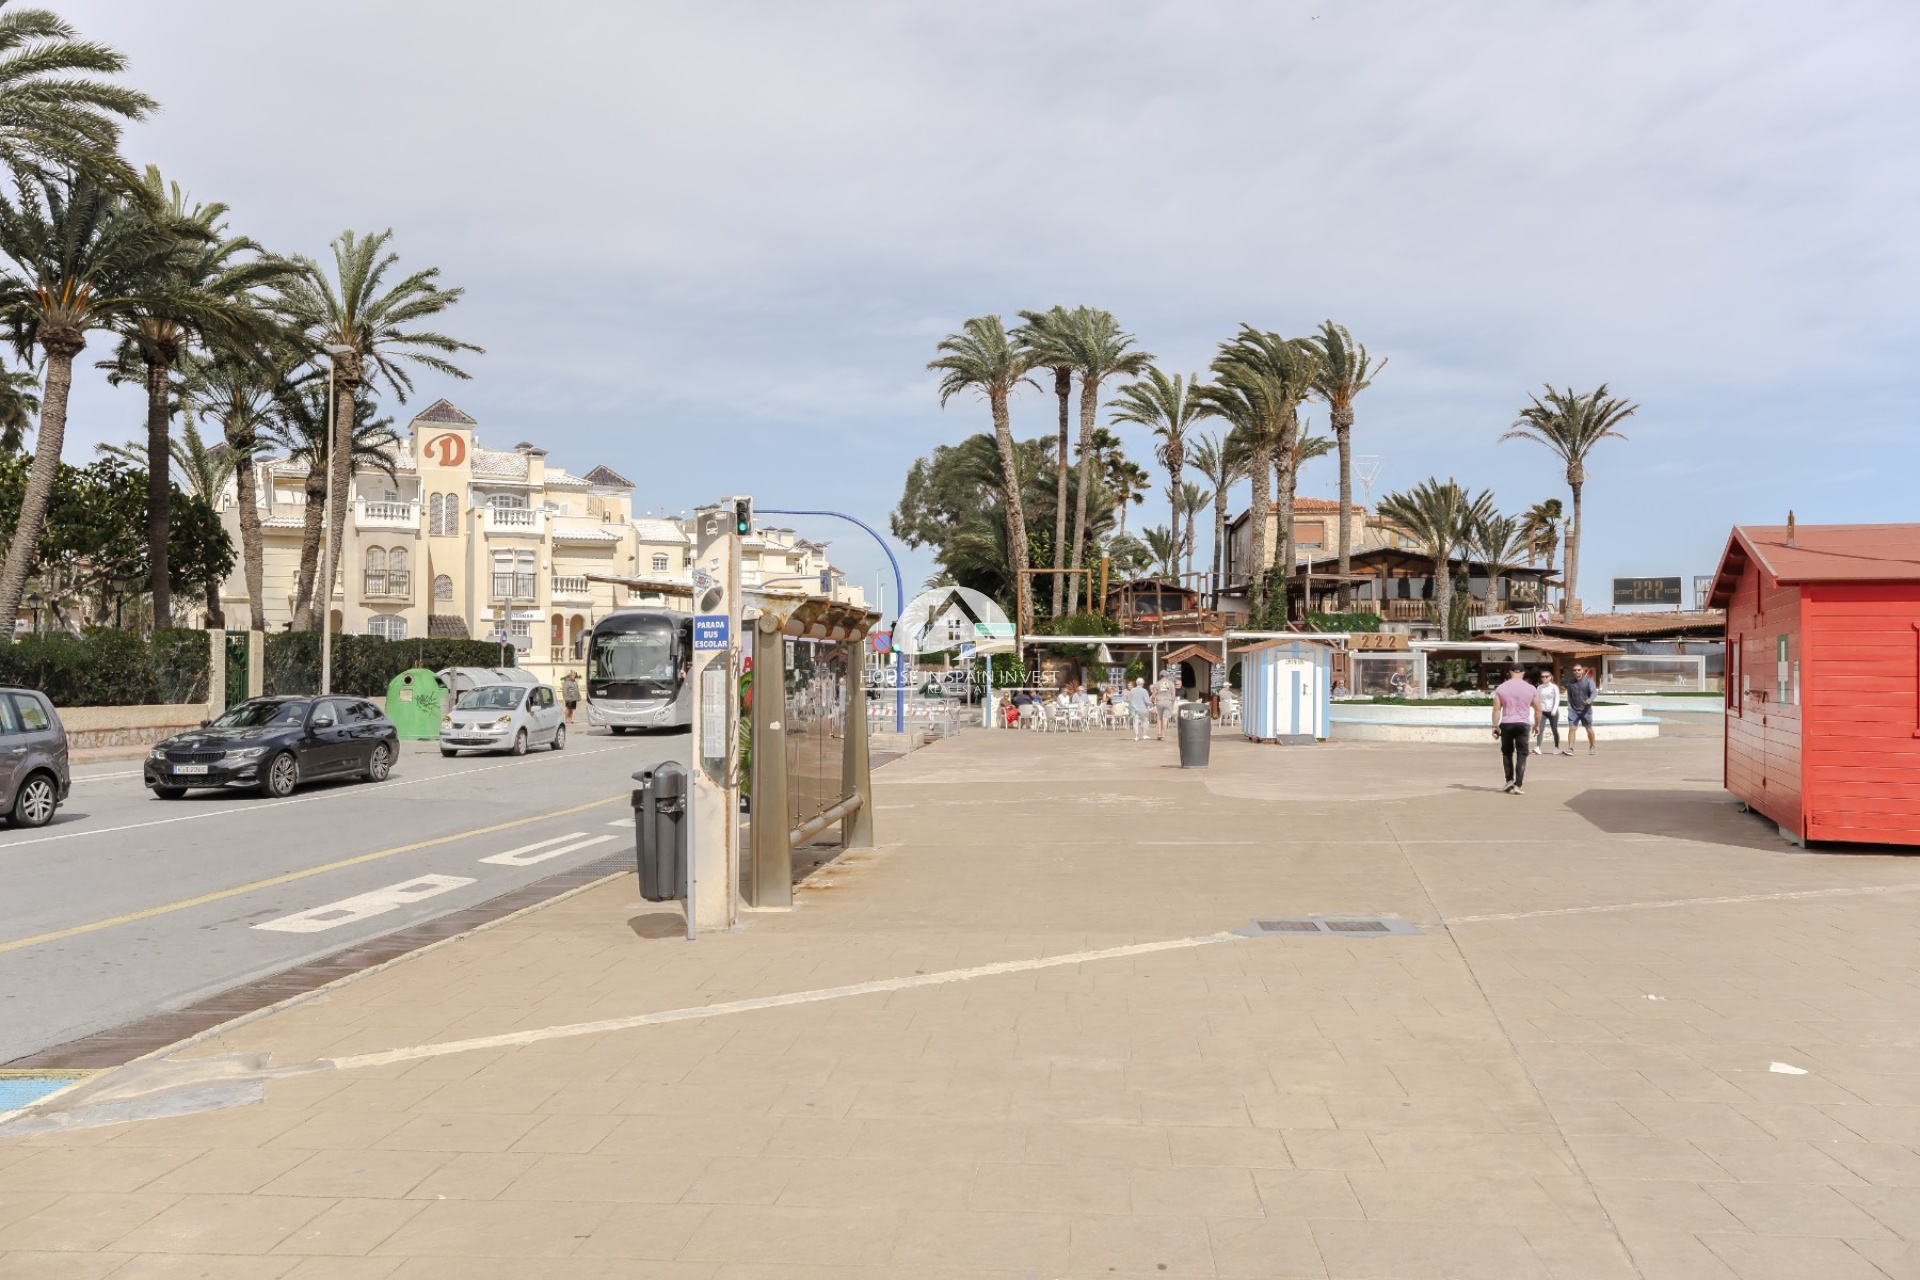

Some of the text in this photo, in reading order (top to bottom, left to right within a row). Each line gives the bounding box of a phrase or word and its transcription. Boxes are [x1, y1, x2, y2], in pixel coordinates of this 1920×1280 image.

[423, 433, 465, 466] D
[1633, 580, 1664, 600] 222
[697, 621, 725, 629] PARADA
[695, 640, 728, 648] ESCOLAR
[1361, 635, 1396, 648] 222
